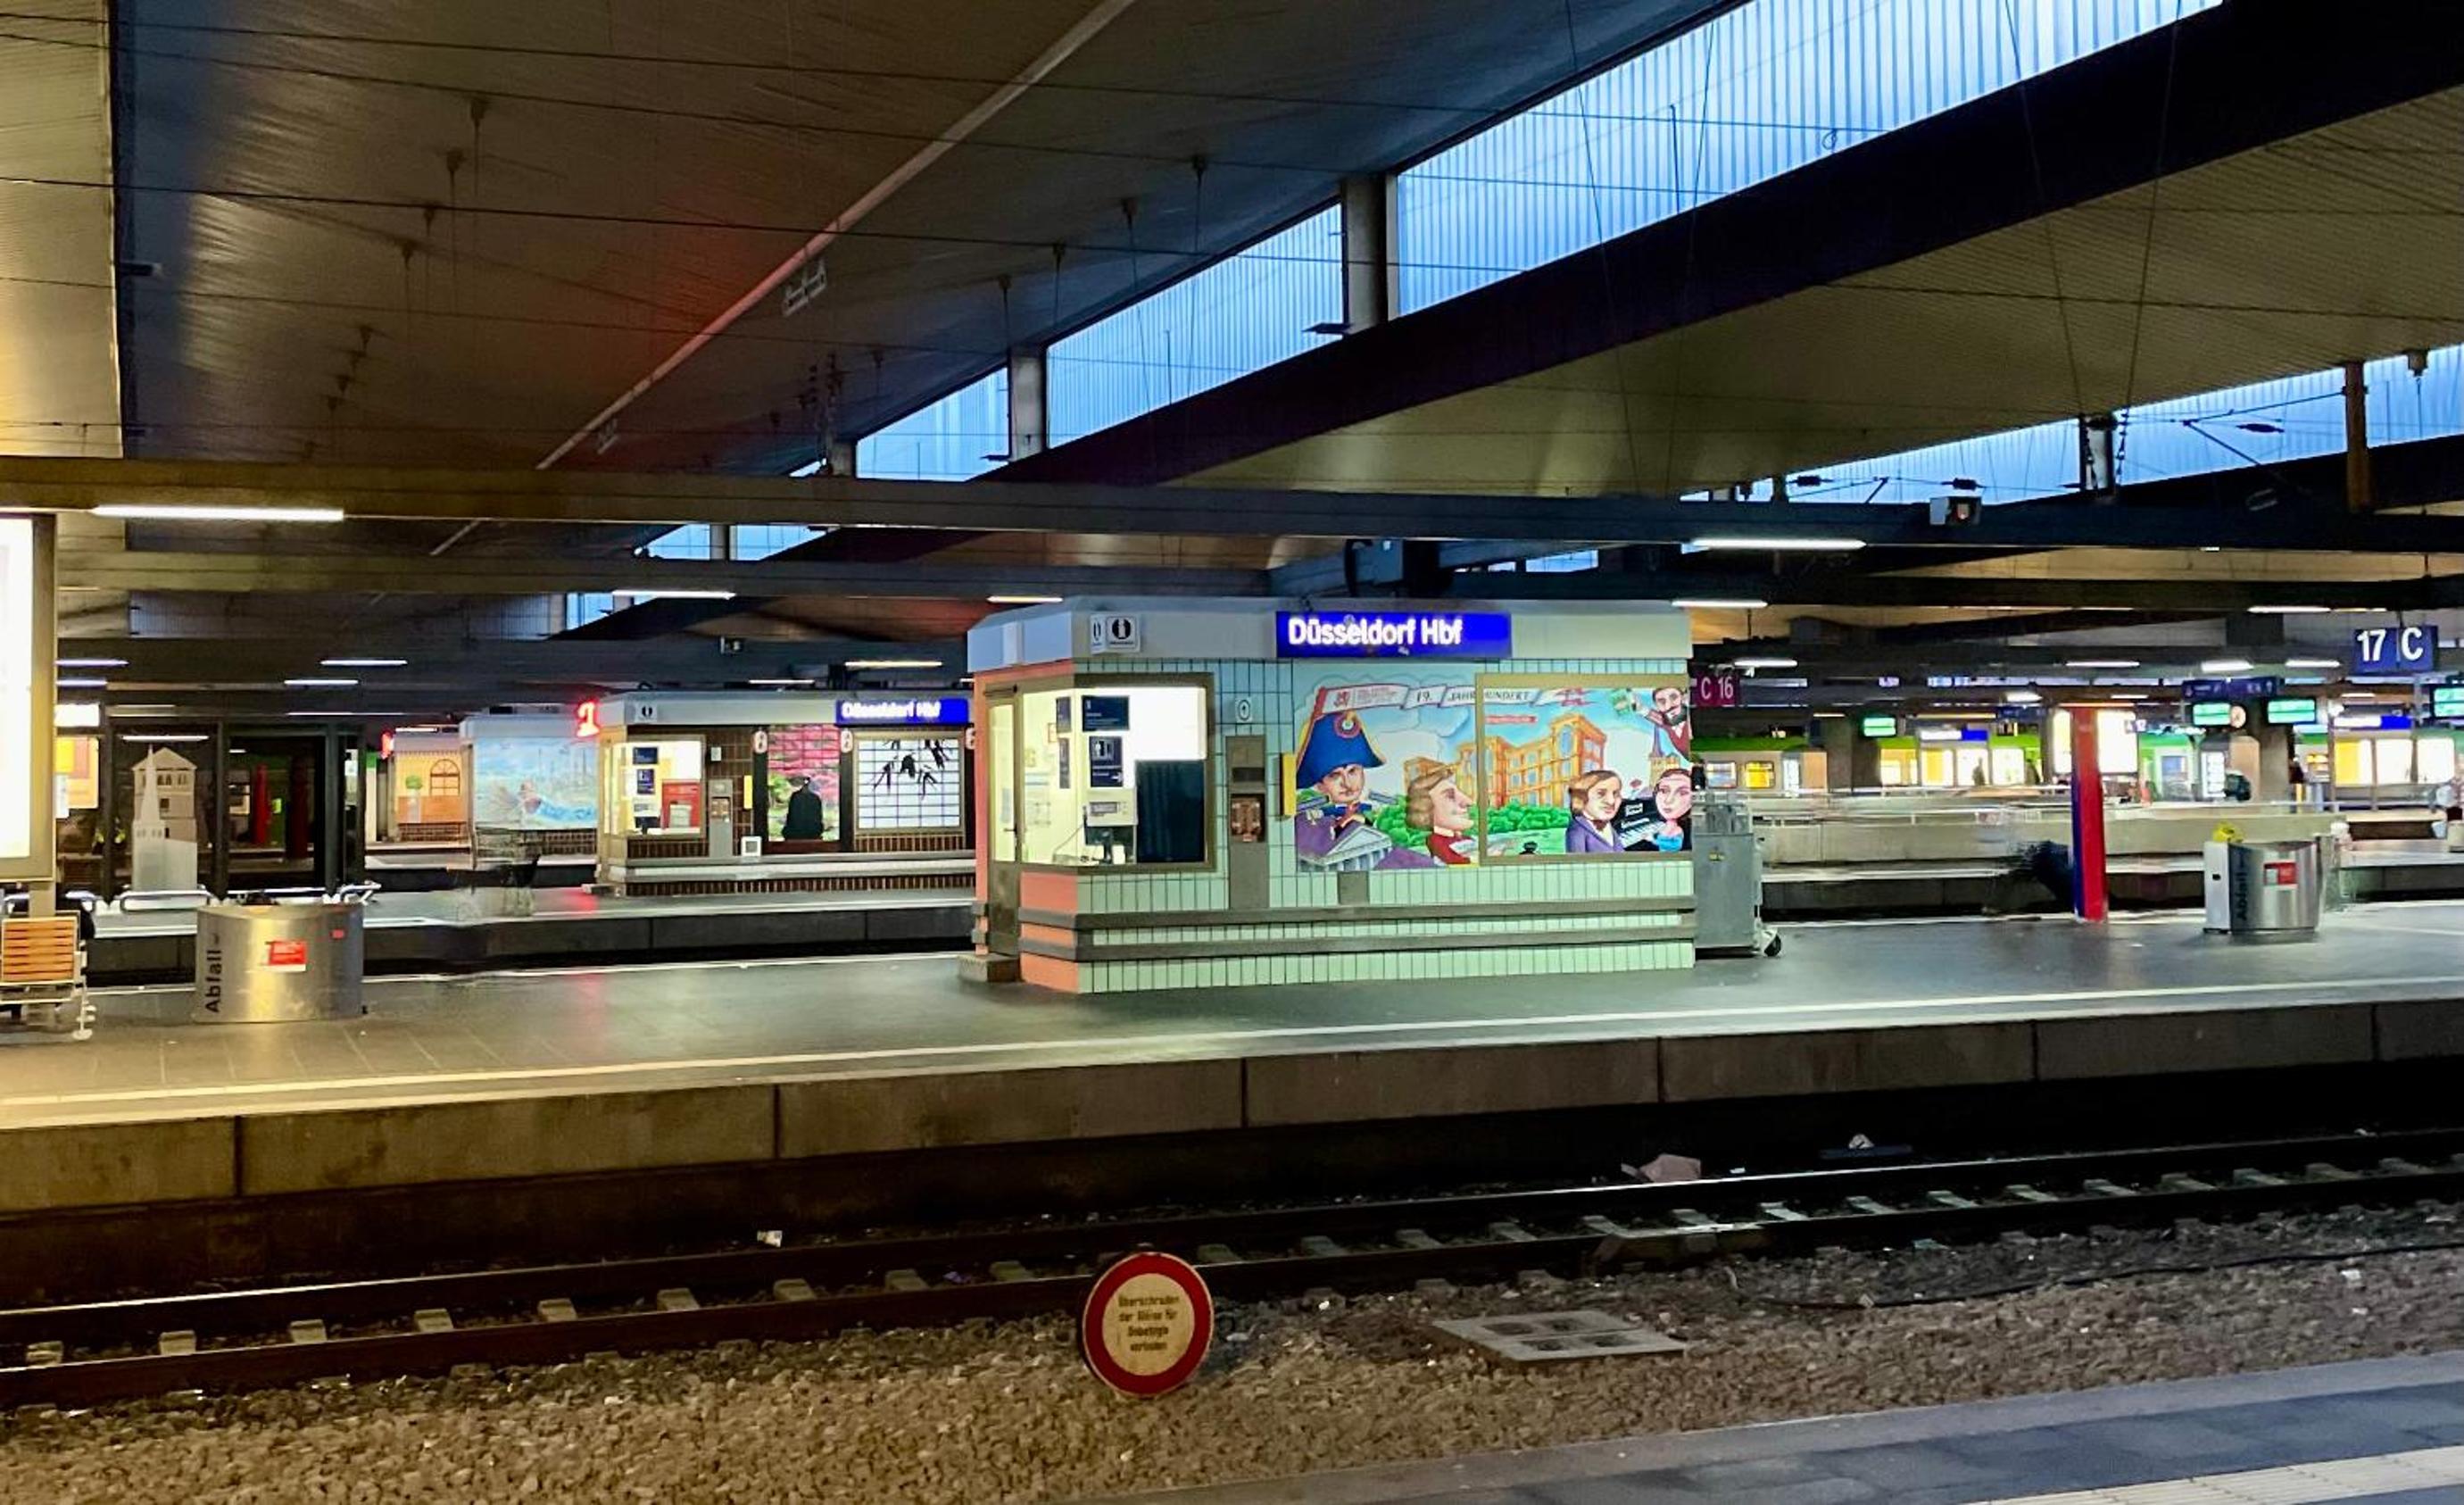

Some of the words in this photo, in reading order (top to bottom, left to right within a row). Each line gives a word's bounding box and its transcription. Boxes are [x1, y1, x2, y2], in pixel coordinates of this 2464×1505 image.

[1288, 617, 1416, 645] Düsseldorf
[1421, 617, 1464, 645] Hbf
[2357, 629, 2387, 661] 17
[2401, 627, 2424, 661] C
[1701, 677, 1712, 700] C
[1718, 676, 1734, 699] 16
[204, 949, 223, 1013] Abfall
